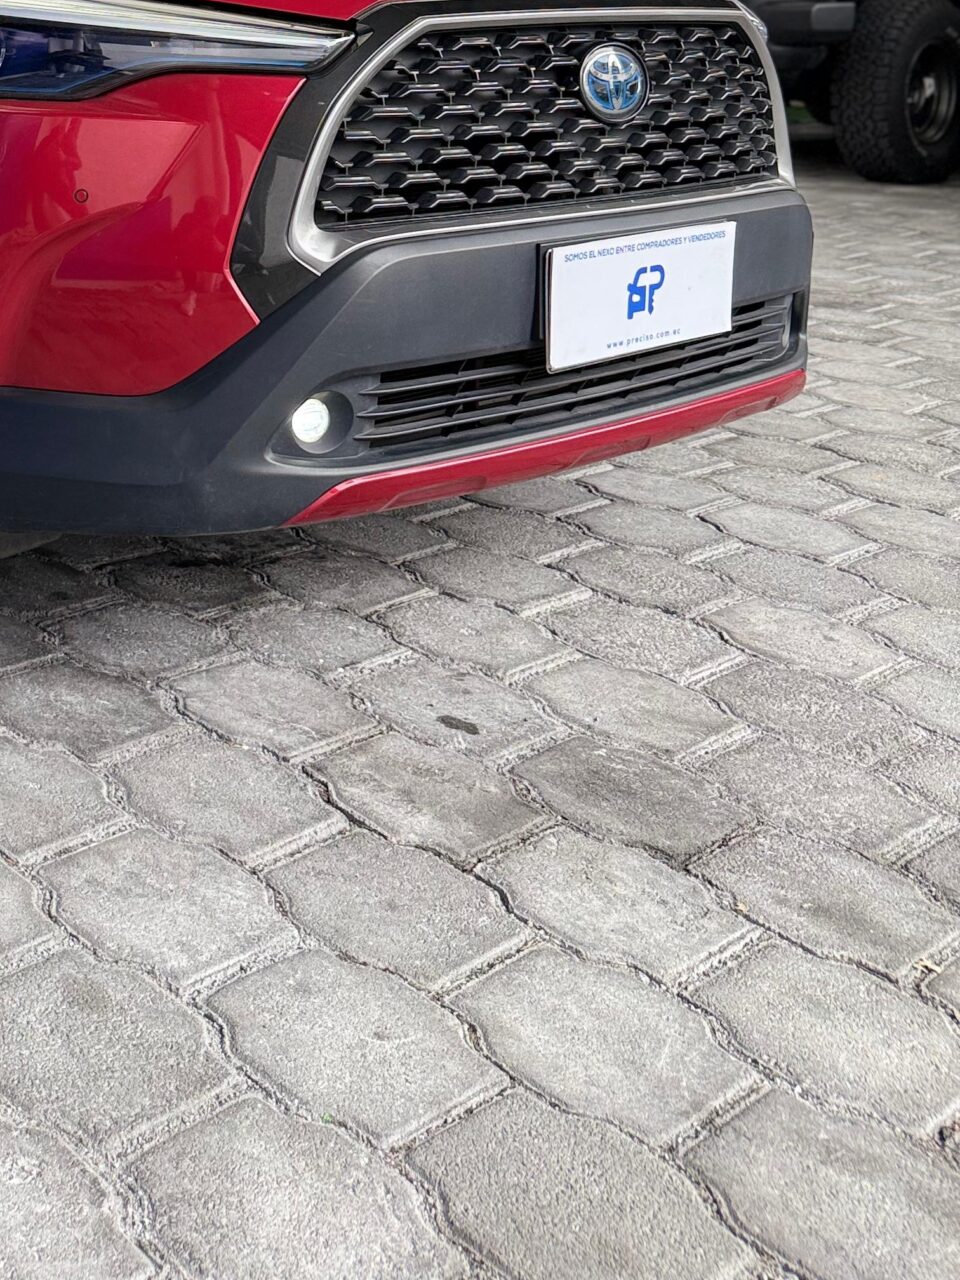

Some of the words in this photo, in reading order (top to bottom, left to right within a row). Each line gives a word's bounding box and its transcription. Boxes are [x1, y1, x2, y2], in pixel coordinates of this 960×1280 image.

[564, 251, 588, 263] SOMOS
[588, 250, 597, 259] EL
[597, 247, 615, 258] NEXO
[615, 243, 636, 255] ENTRE
[637, 235, 683, 252] COMPRADORES
[688, 230, 727, 244] VENDEDORES
